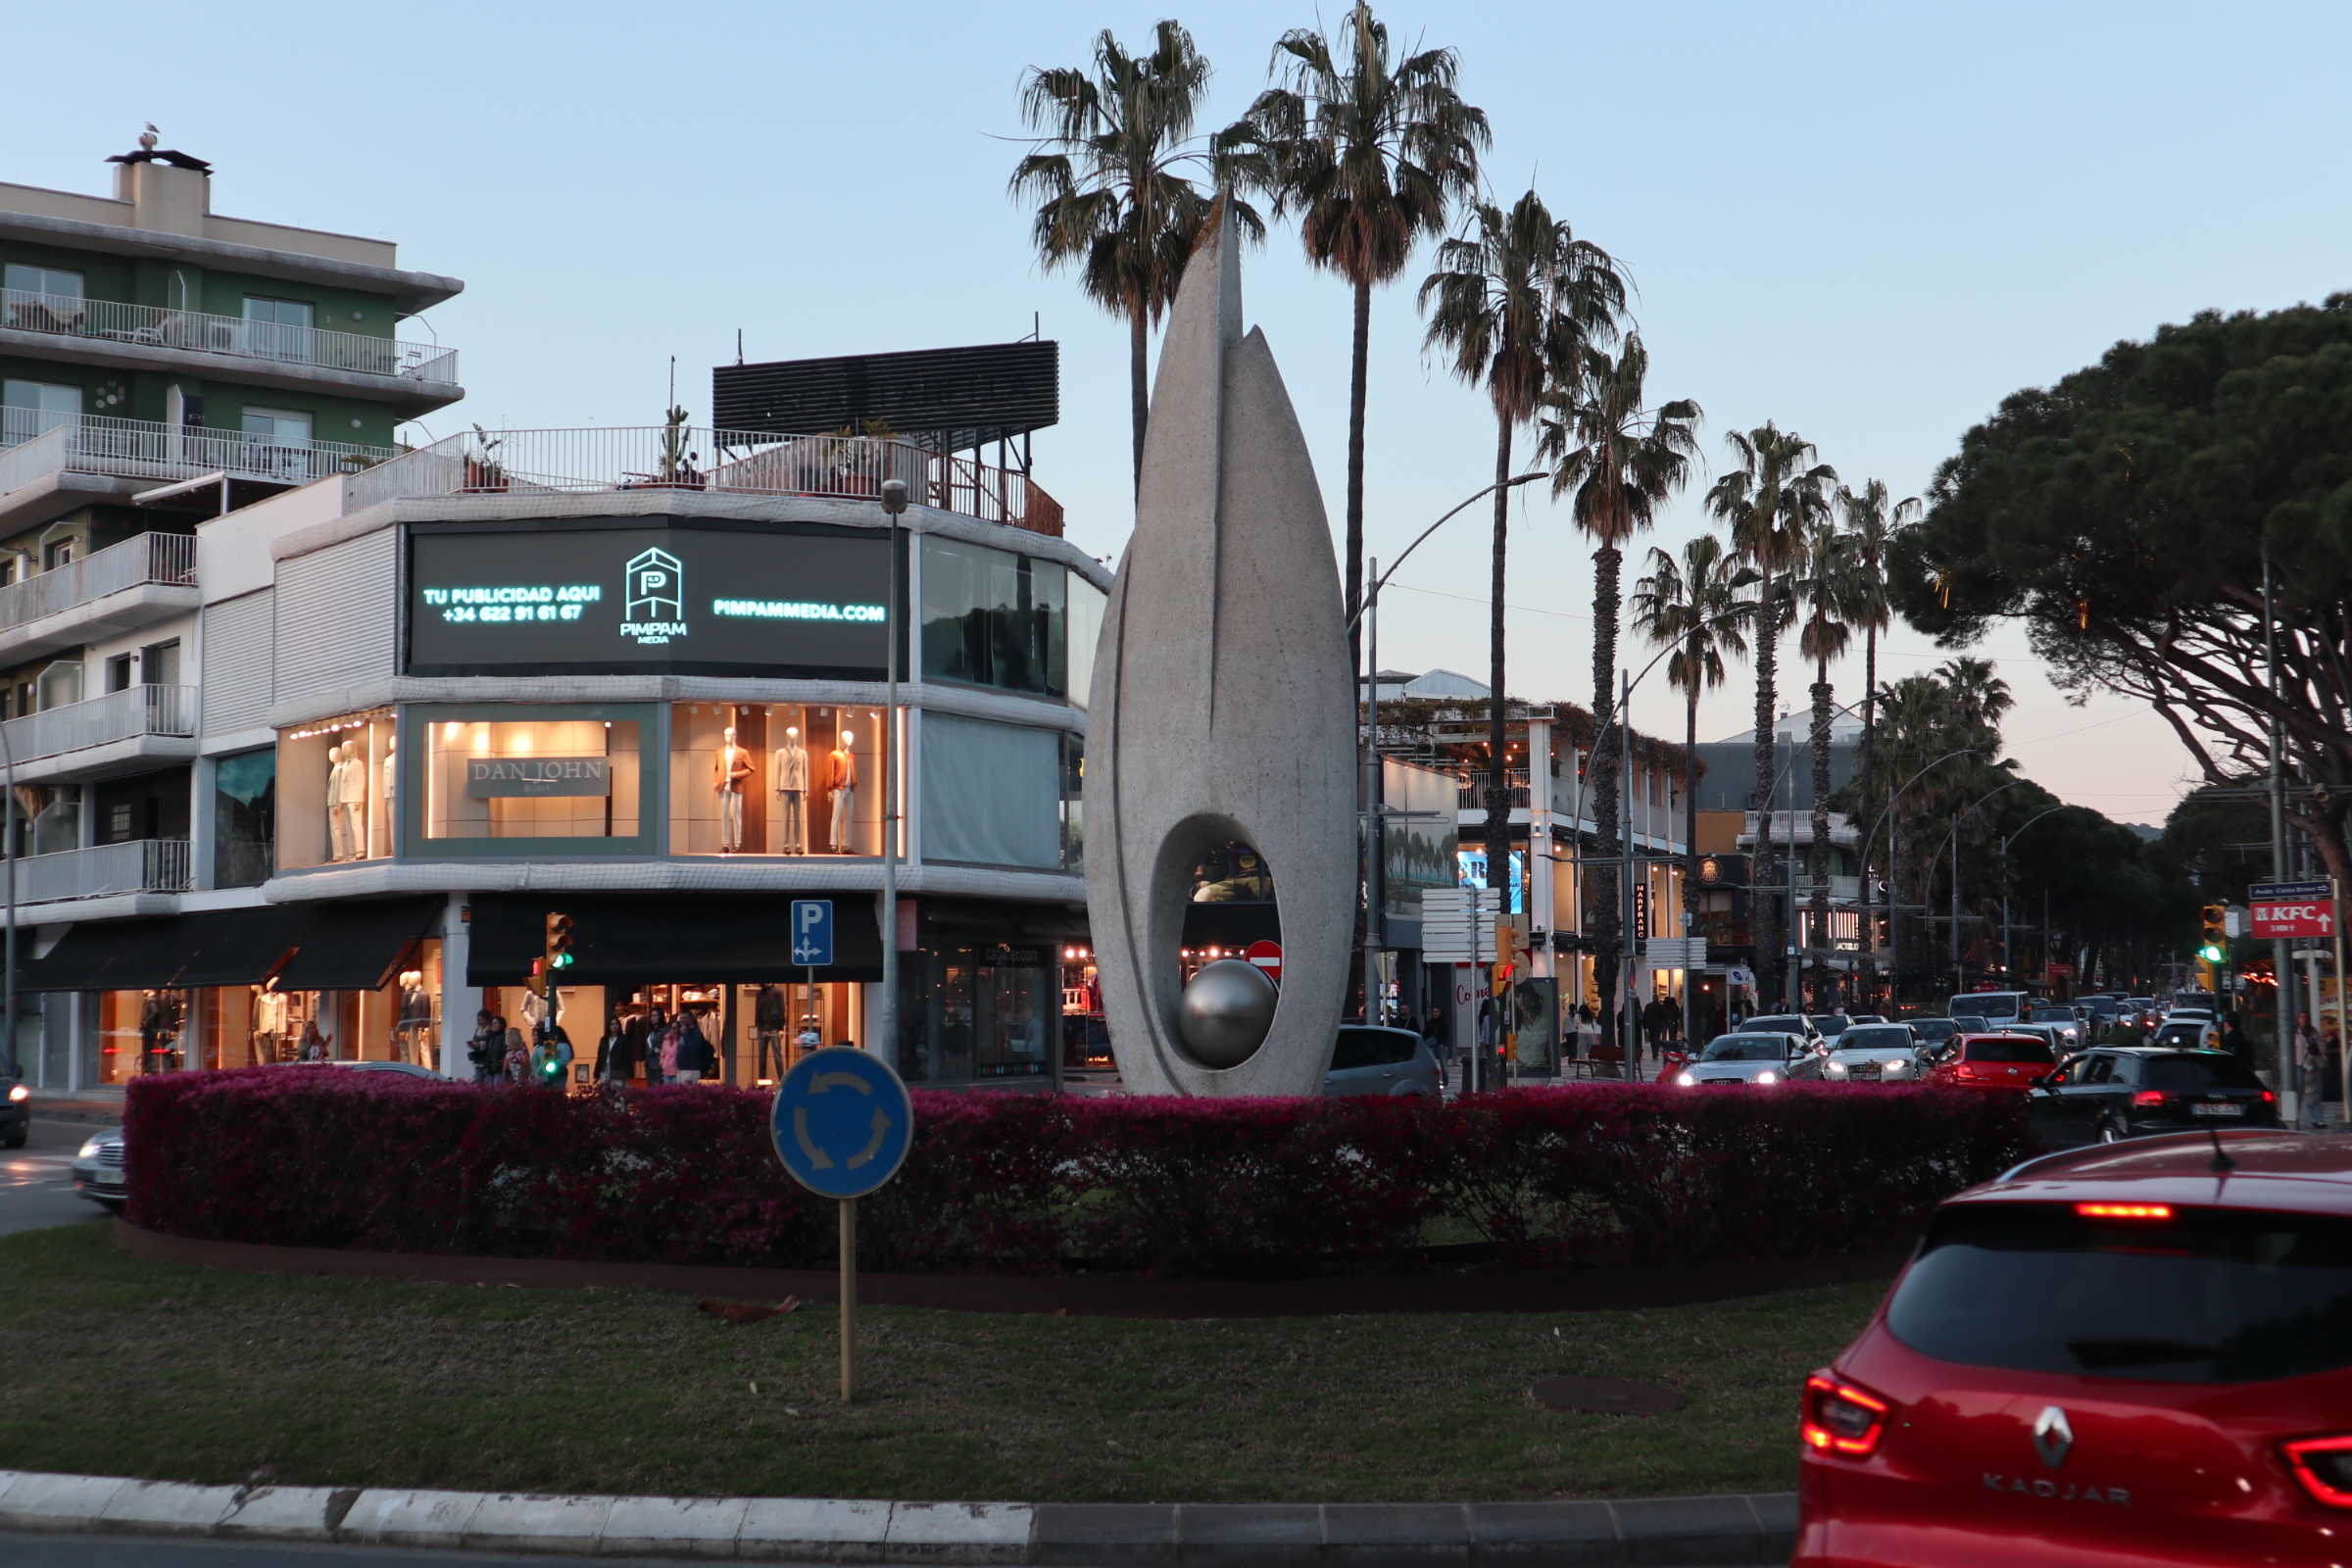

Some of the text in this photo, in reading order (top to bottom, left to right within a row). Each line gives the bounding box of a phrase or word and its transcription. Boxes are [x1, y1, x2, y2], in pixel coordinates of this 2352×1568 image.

[423, 585, 601, 605] TU PUBLICIDAD AQUI
[442, 604, 583, 621] +34 622 91 61 67
[713, 599, 885, 621] PIMPAMMEDIA.COM
[619, 622, 687, 636] PIMPAM
[472, 761, 603, 783] DAN JOHN
[802, 904, 823, 934] P
[2271, 906, 2316, 921] KFC
[1983, 1473, 2133, 1507] KADJAR
